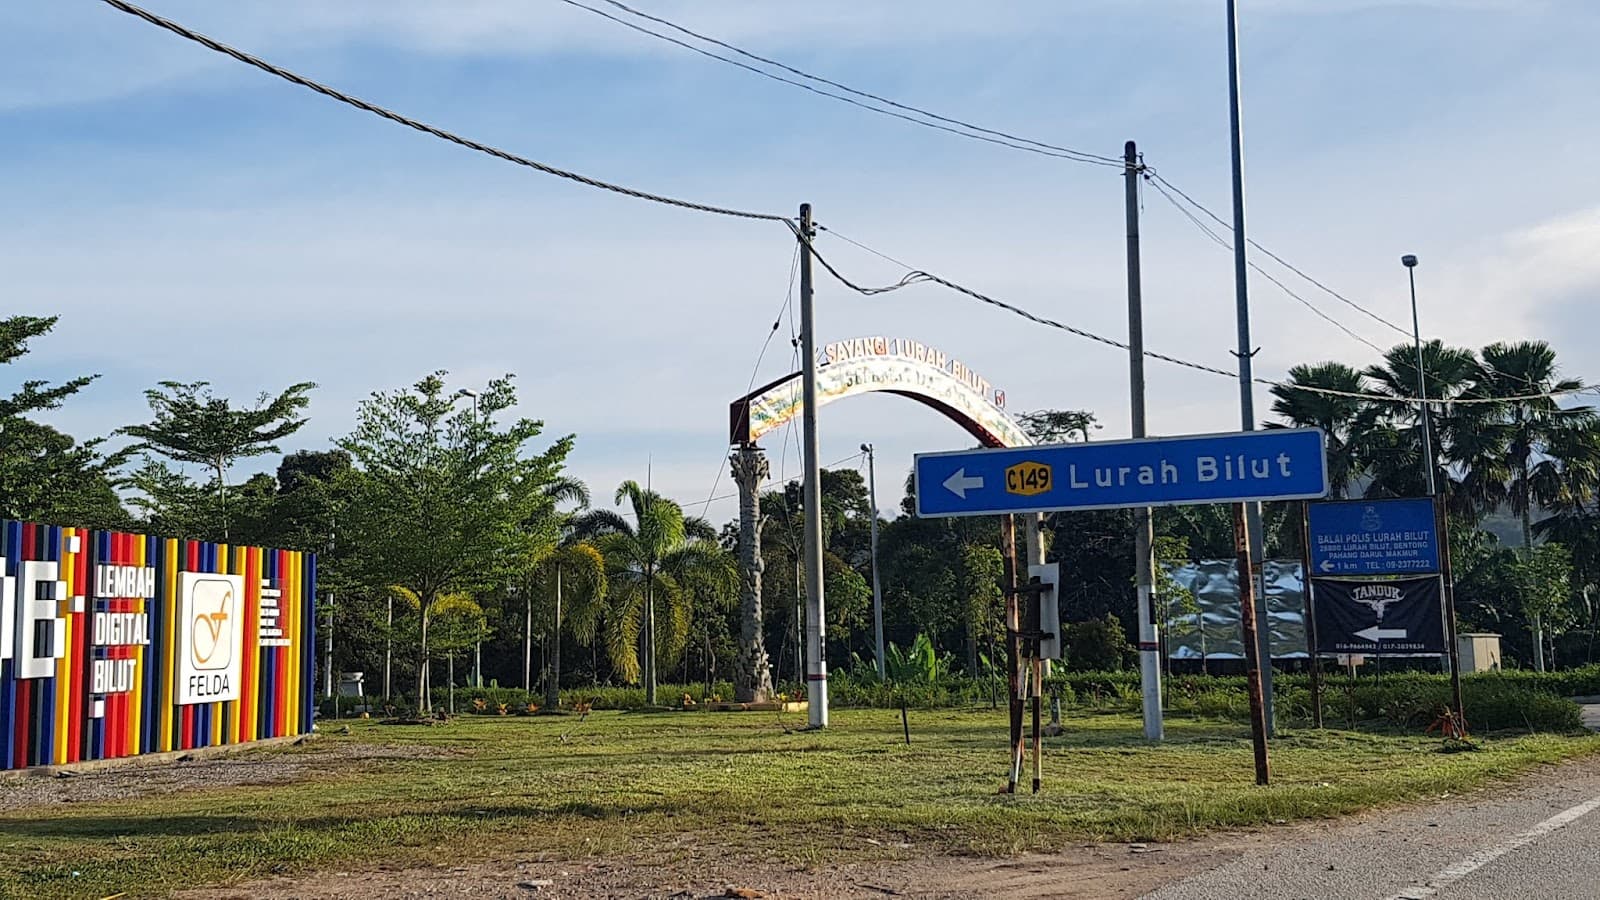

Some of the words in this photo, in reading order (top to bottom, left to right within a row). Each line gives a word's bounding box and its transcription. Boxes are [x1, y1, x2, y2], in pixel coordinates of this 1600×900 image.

[825, 336, 889, 363] SAYANGI
[894, 338, 947, 370] LURAH
[951, 359, 991, 397] BILUT
[1007, 466, 1049, 490] C149
[1070, 458, 1178, 489] Lurah
[1197, 452, 1292, 482] Bilut
[1318, 535, 1343, 544] BALAI
[1346, 533, 1370, 542] POLIS
[1373, 532, 1401, 541] LURAH
[1404, 531, 1429, 540] BILUT
[1394, 541, 1428, 549] BENTONG
[97, 564, 155, 598] LEMBAH
[1352, 585, 1401, 599] TANDUK
[95, 612, 150, 645] DIGITAL
[93, 659, 136, 693] BILUT
[189, 674, 230, 697] FELDA
